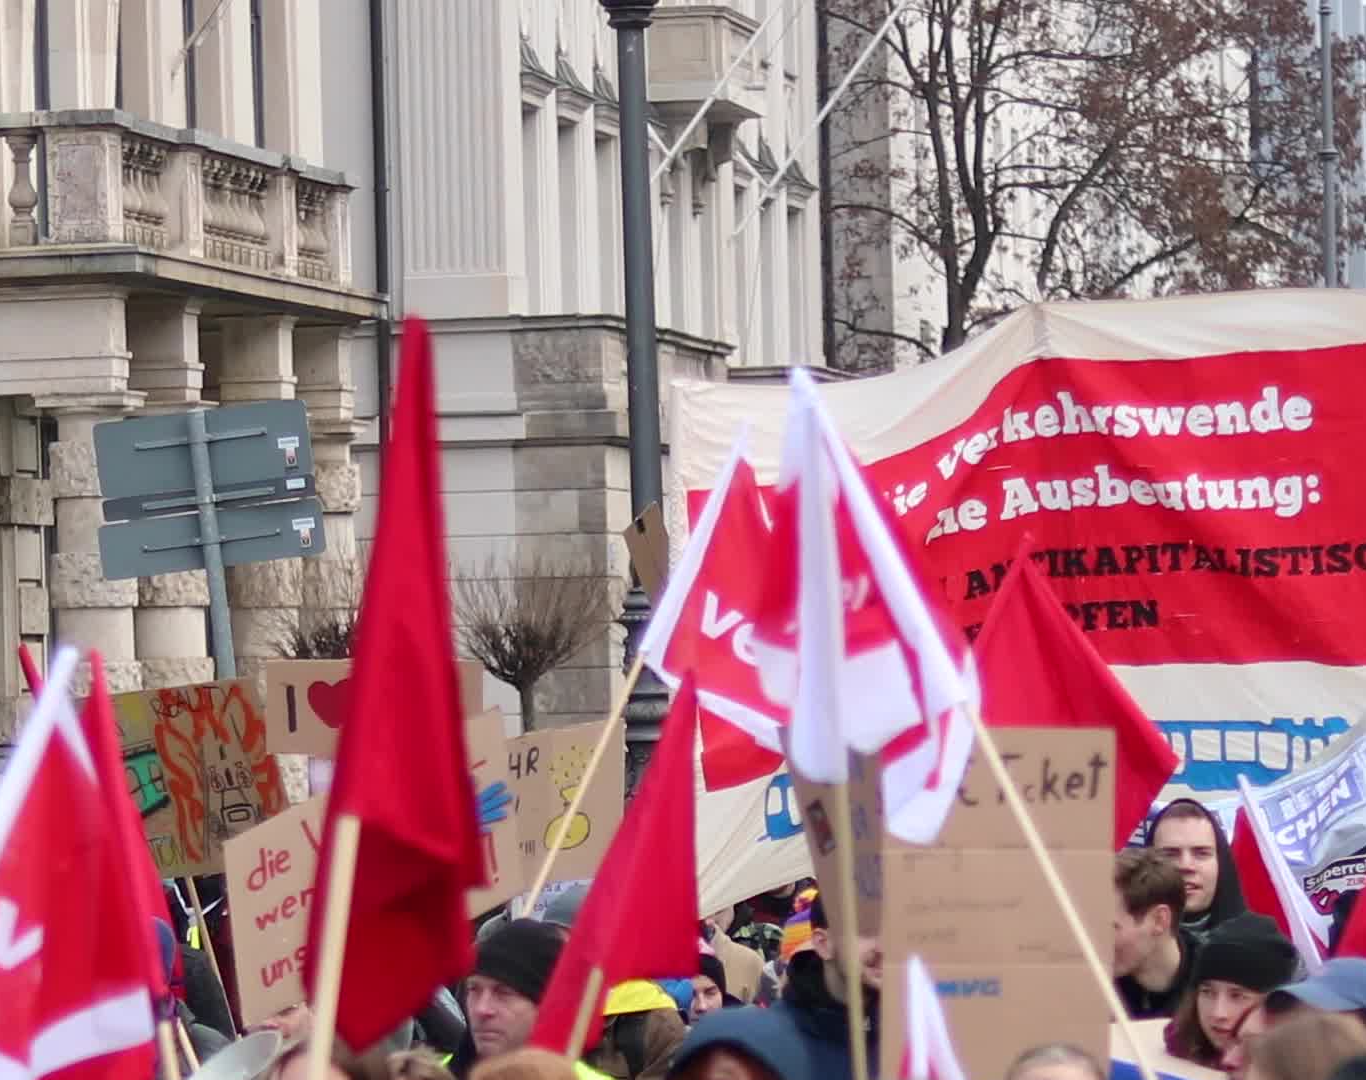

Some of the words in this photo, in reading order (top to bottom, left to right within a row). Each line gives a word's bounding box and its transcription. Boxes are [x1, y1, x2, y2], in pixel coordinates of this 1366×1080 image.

[884, 480, 929, 517] ie
[937, 386, 1313, 480] Verkehrswende
[1000, 464, 1321, 521] Ausbeutung:
[286, 684, 298, 733] I
[246, 848, 292, 892] die
[255, 886, 317, 931] wer
